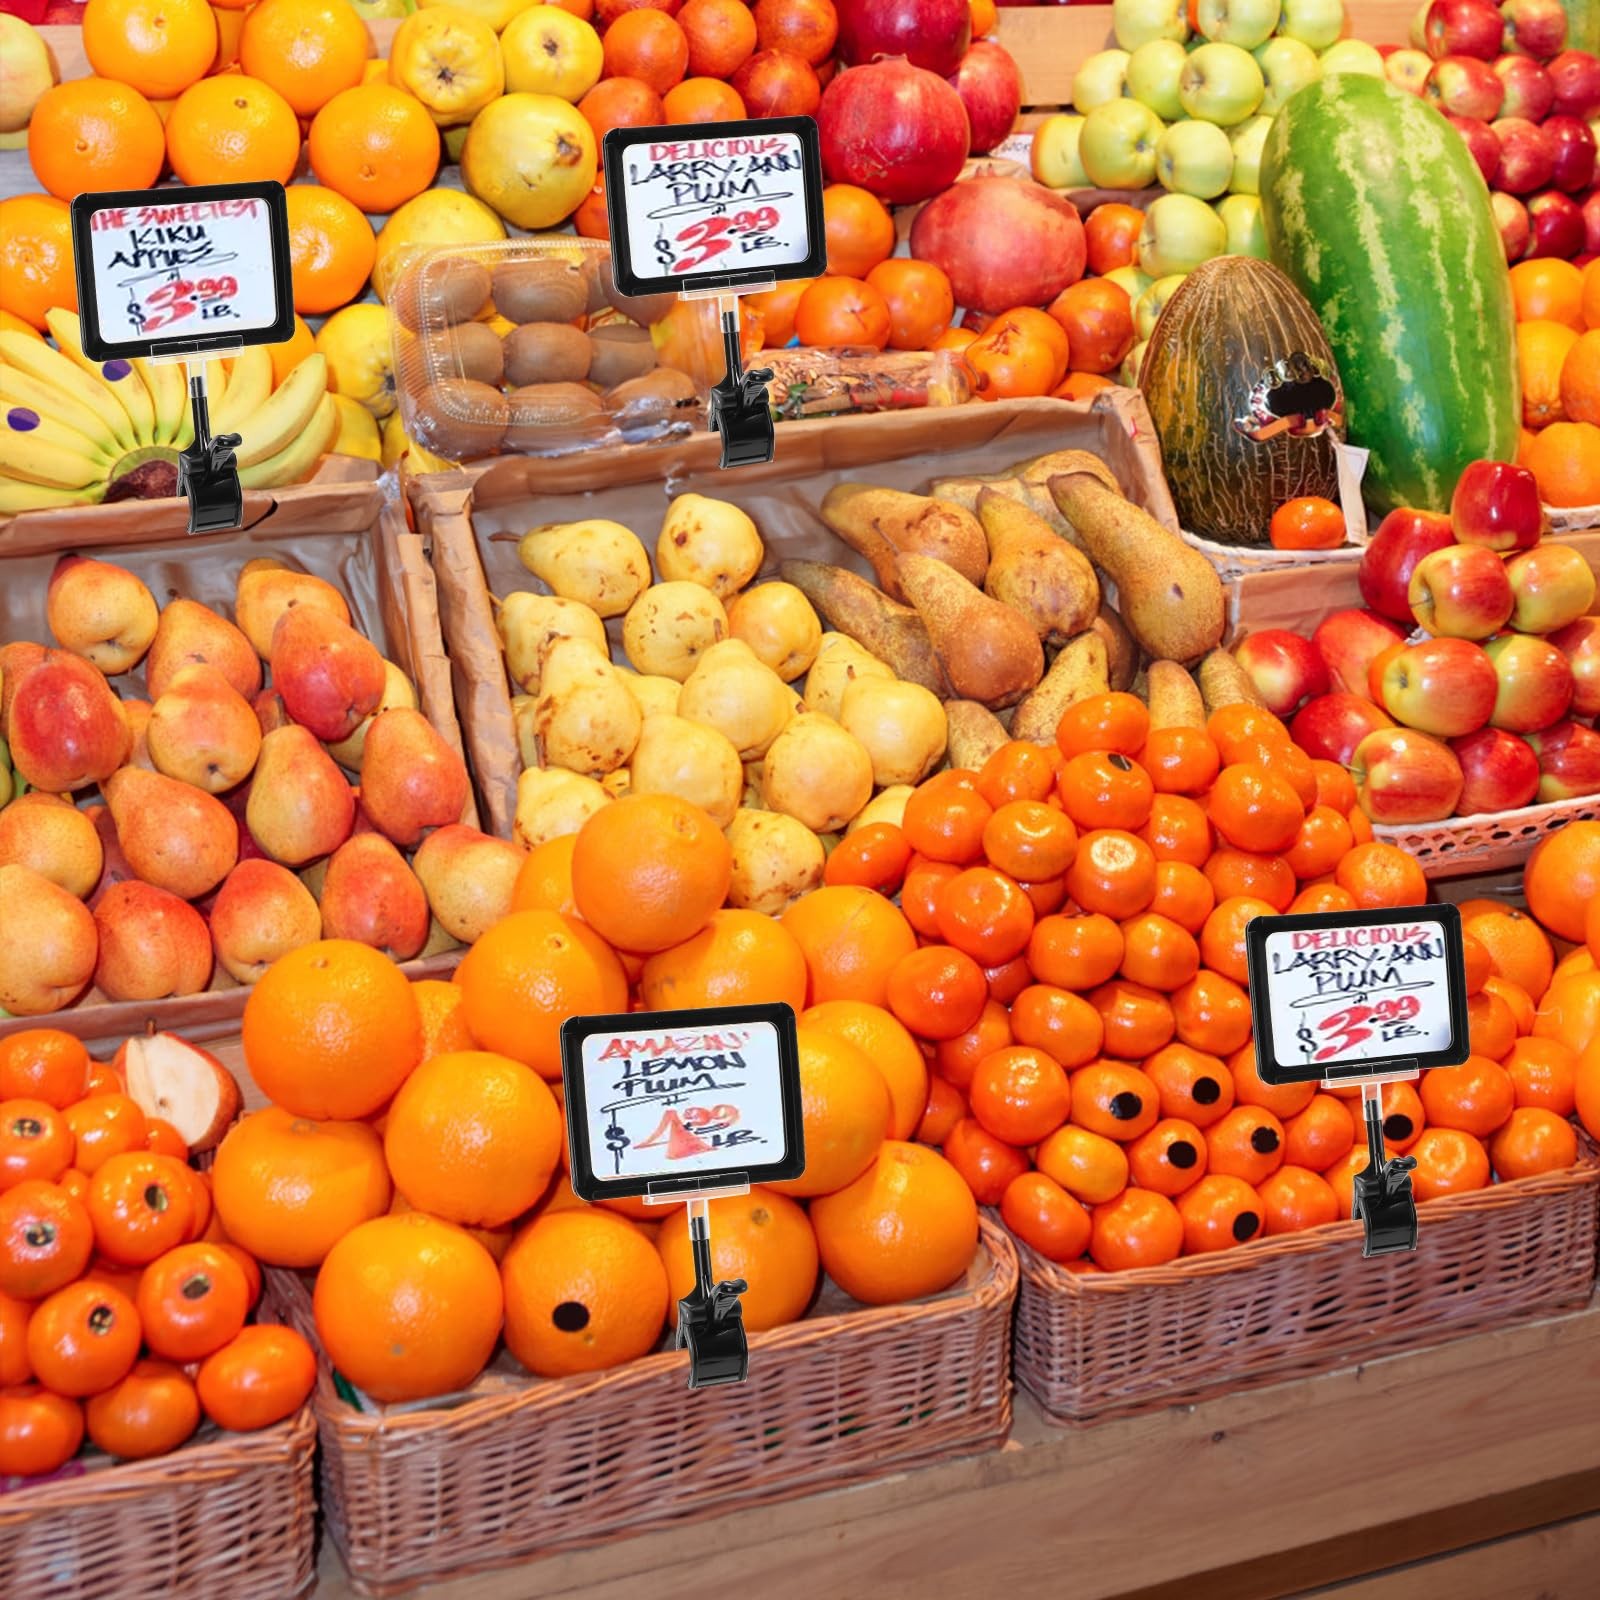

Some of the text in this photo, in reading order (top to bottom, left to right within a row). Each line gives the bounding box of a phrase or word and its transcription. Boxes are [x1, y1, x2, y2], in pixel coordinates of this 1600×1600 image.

[650, 138, 788, 161] DELICIOUS
[629, 150, 801, 185] LARRY-ANN
[666, 178, 760, 204] PLUM
[91, 198, 259, 232] THE SWEETEST
[130, 224, 206, 249] KIKU
[107, 240, 215, 269] APPLES
[1291, 926, 1431, 950] DELICIOUS
[1273, 938, 1444, 974] LARRY-ANN
[1308, 966, 1403, 994] PLUM
[623, 1051, 746, 1079] LEMON
[613, 1073, 717, 1097] PLUM
